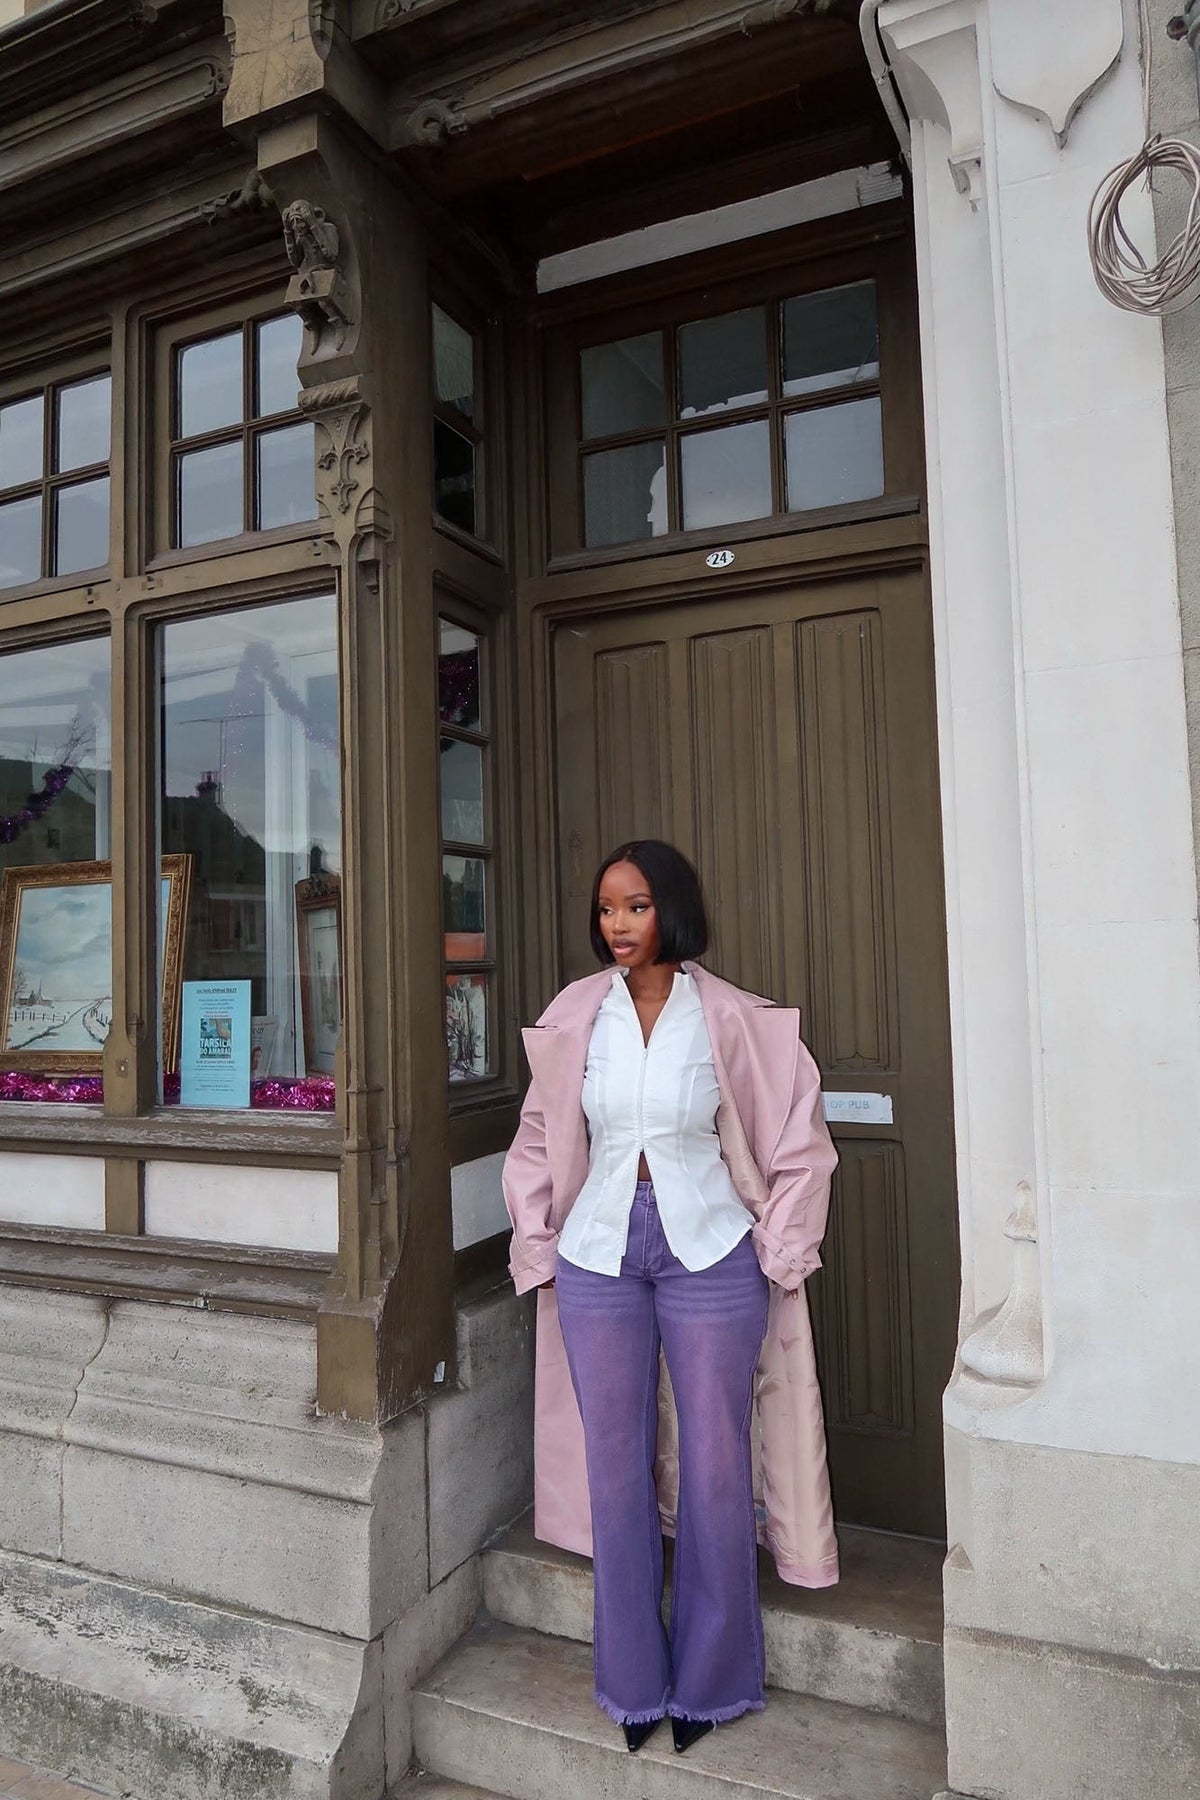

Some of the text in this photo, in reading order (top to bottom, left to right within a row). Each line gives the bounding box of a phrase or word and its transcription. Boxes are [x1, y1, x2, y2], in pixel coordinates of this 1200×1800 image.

[711, 552, 727, 565] 24
[200, 1038, 231, 1048] TARSILA
[847, 1100, 870, 1109] PUB
